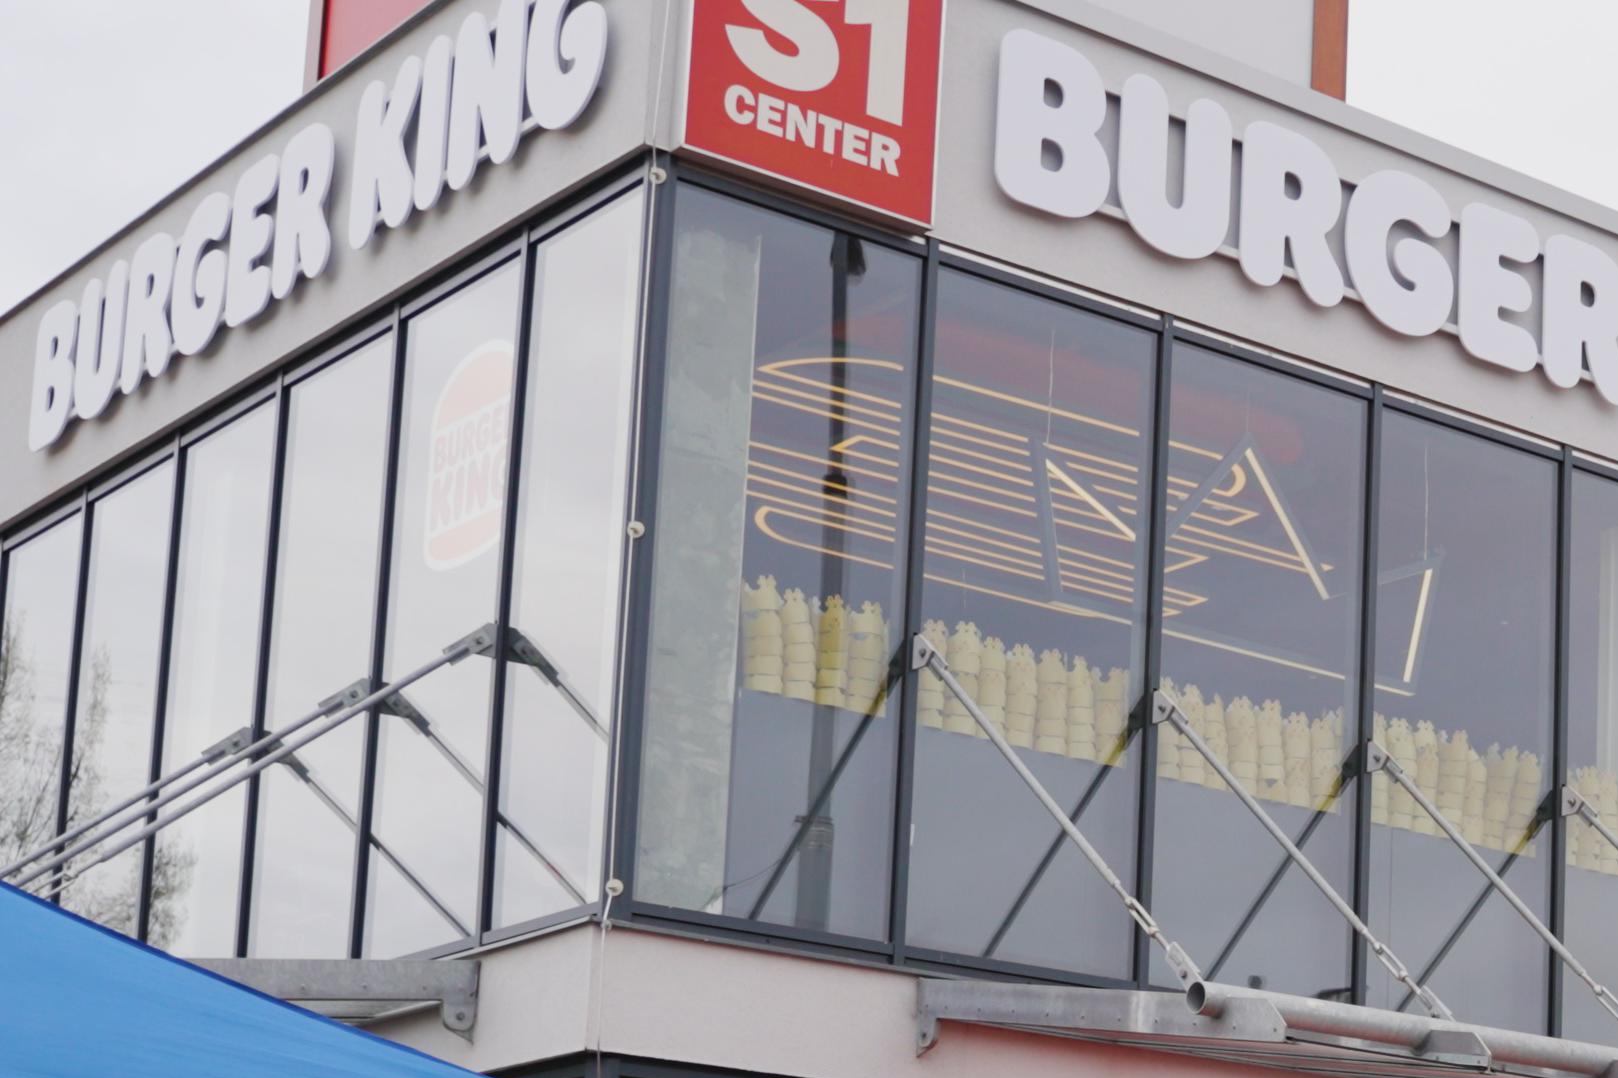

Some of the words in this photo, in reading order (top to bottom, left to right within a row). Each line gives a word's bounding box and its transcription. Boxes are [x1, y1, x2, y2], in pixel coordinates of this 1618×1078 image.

[725, 0, 910, 127] S1
[724, 84, 901, 177] CENTER
[29, 122, 335, 453] BURGER
[349, 0, 608, 250] KING
[433, 403, 509, 475] BURGE
